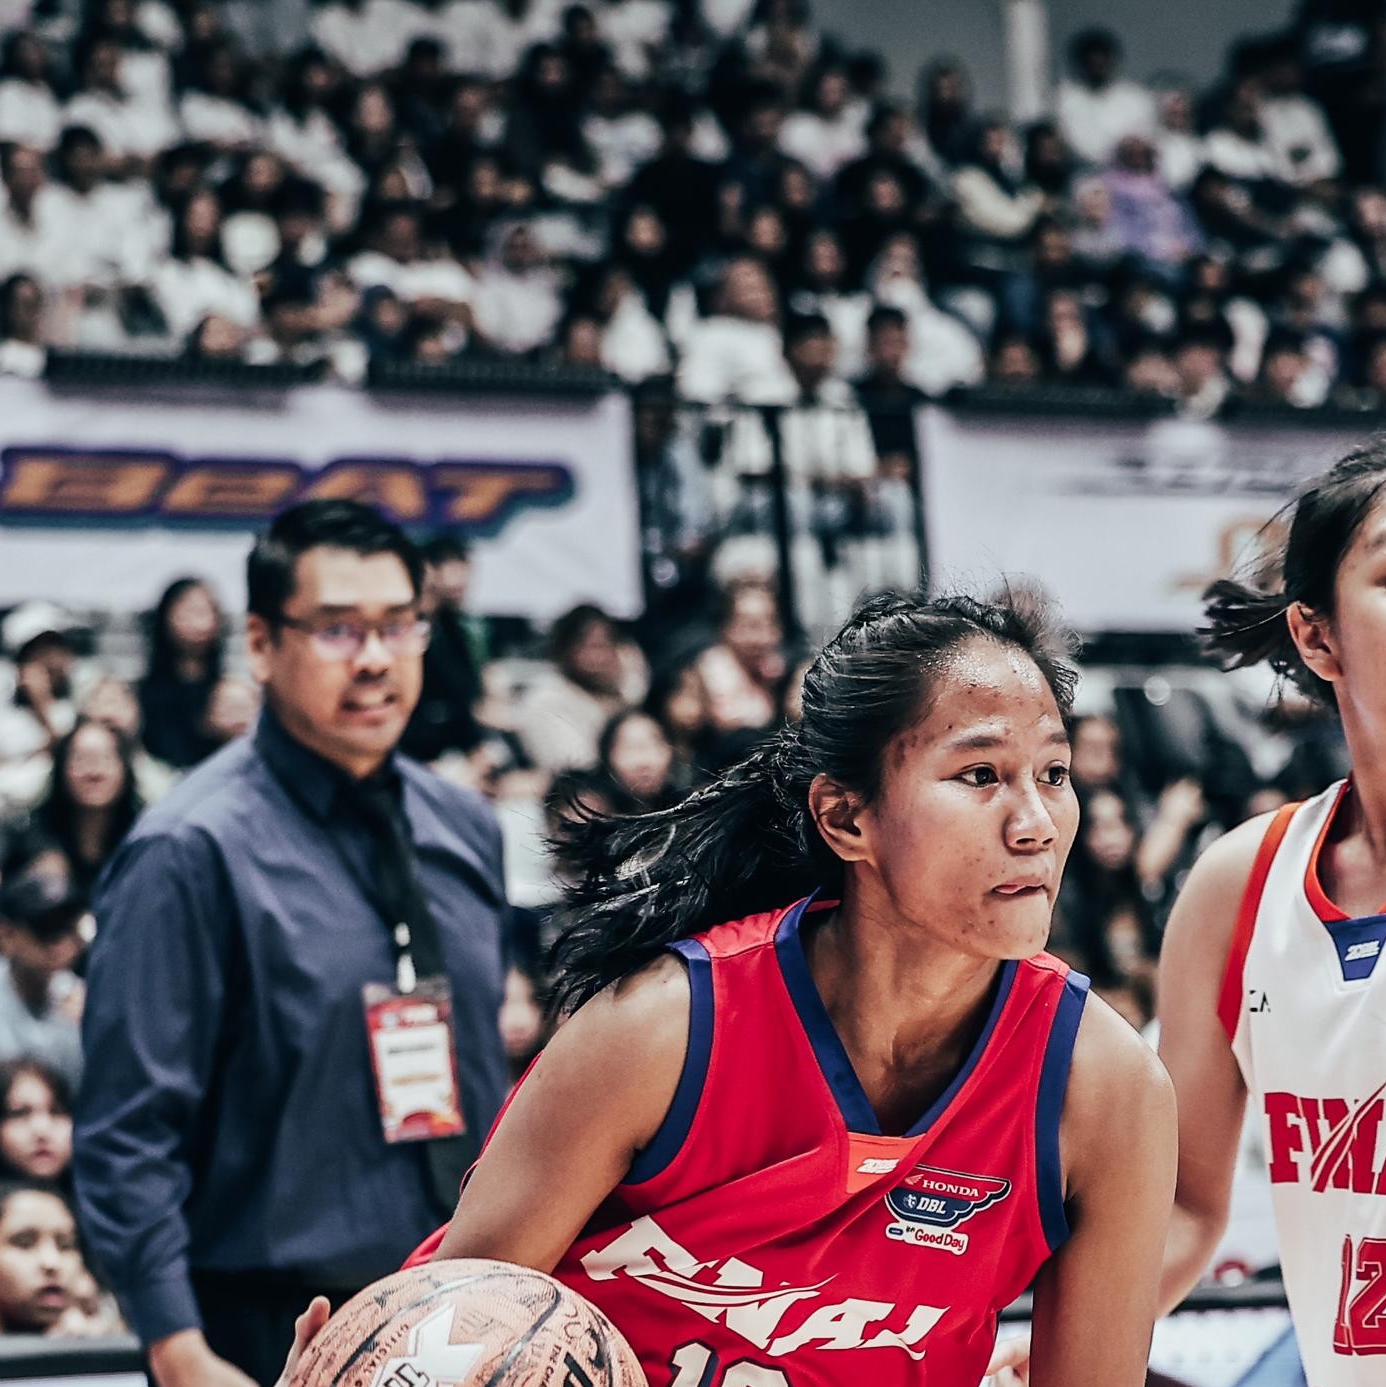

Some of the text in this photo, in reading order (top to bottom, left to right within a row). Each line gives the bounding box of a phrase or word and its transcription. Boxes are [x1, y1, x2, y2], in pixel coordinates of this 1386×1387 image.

[922, 1179, 980, 1197] HONDA
[916, 1196, 947, 1215] DBL
[914, 1228, 945, 1245] Good
[943, 1233, 965, 1251] Day
